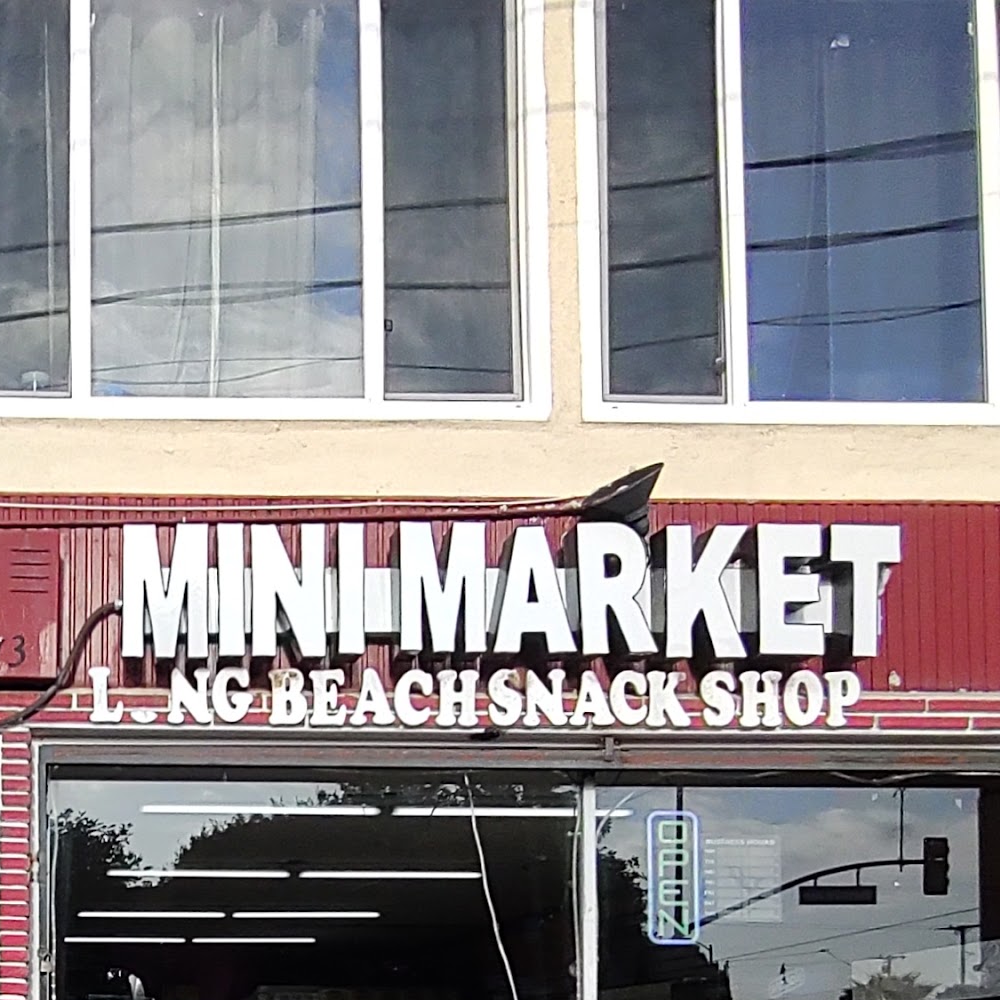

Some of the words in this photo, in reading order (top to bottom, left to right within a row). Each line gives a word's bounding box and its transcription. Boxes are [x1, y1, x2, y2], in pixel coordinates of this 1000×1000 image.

[121, 522, 365, 658] MINI
[399, 521, 901, 658] MARKET
[88, 666, 252, 725] LNG
[268, 667, 480, 728] BEACH
[487, 668, 691, 728] SNACK
[700, 670, 861, 728] SHOP
[658, 820, 689, 937] OPEN
